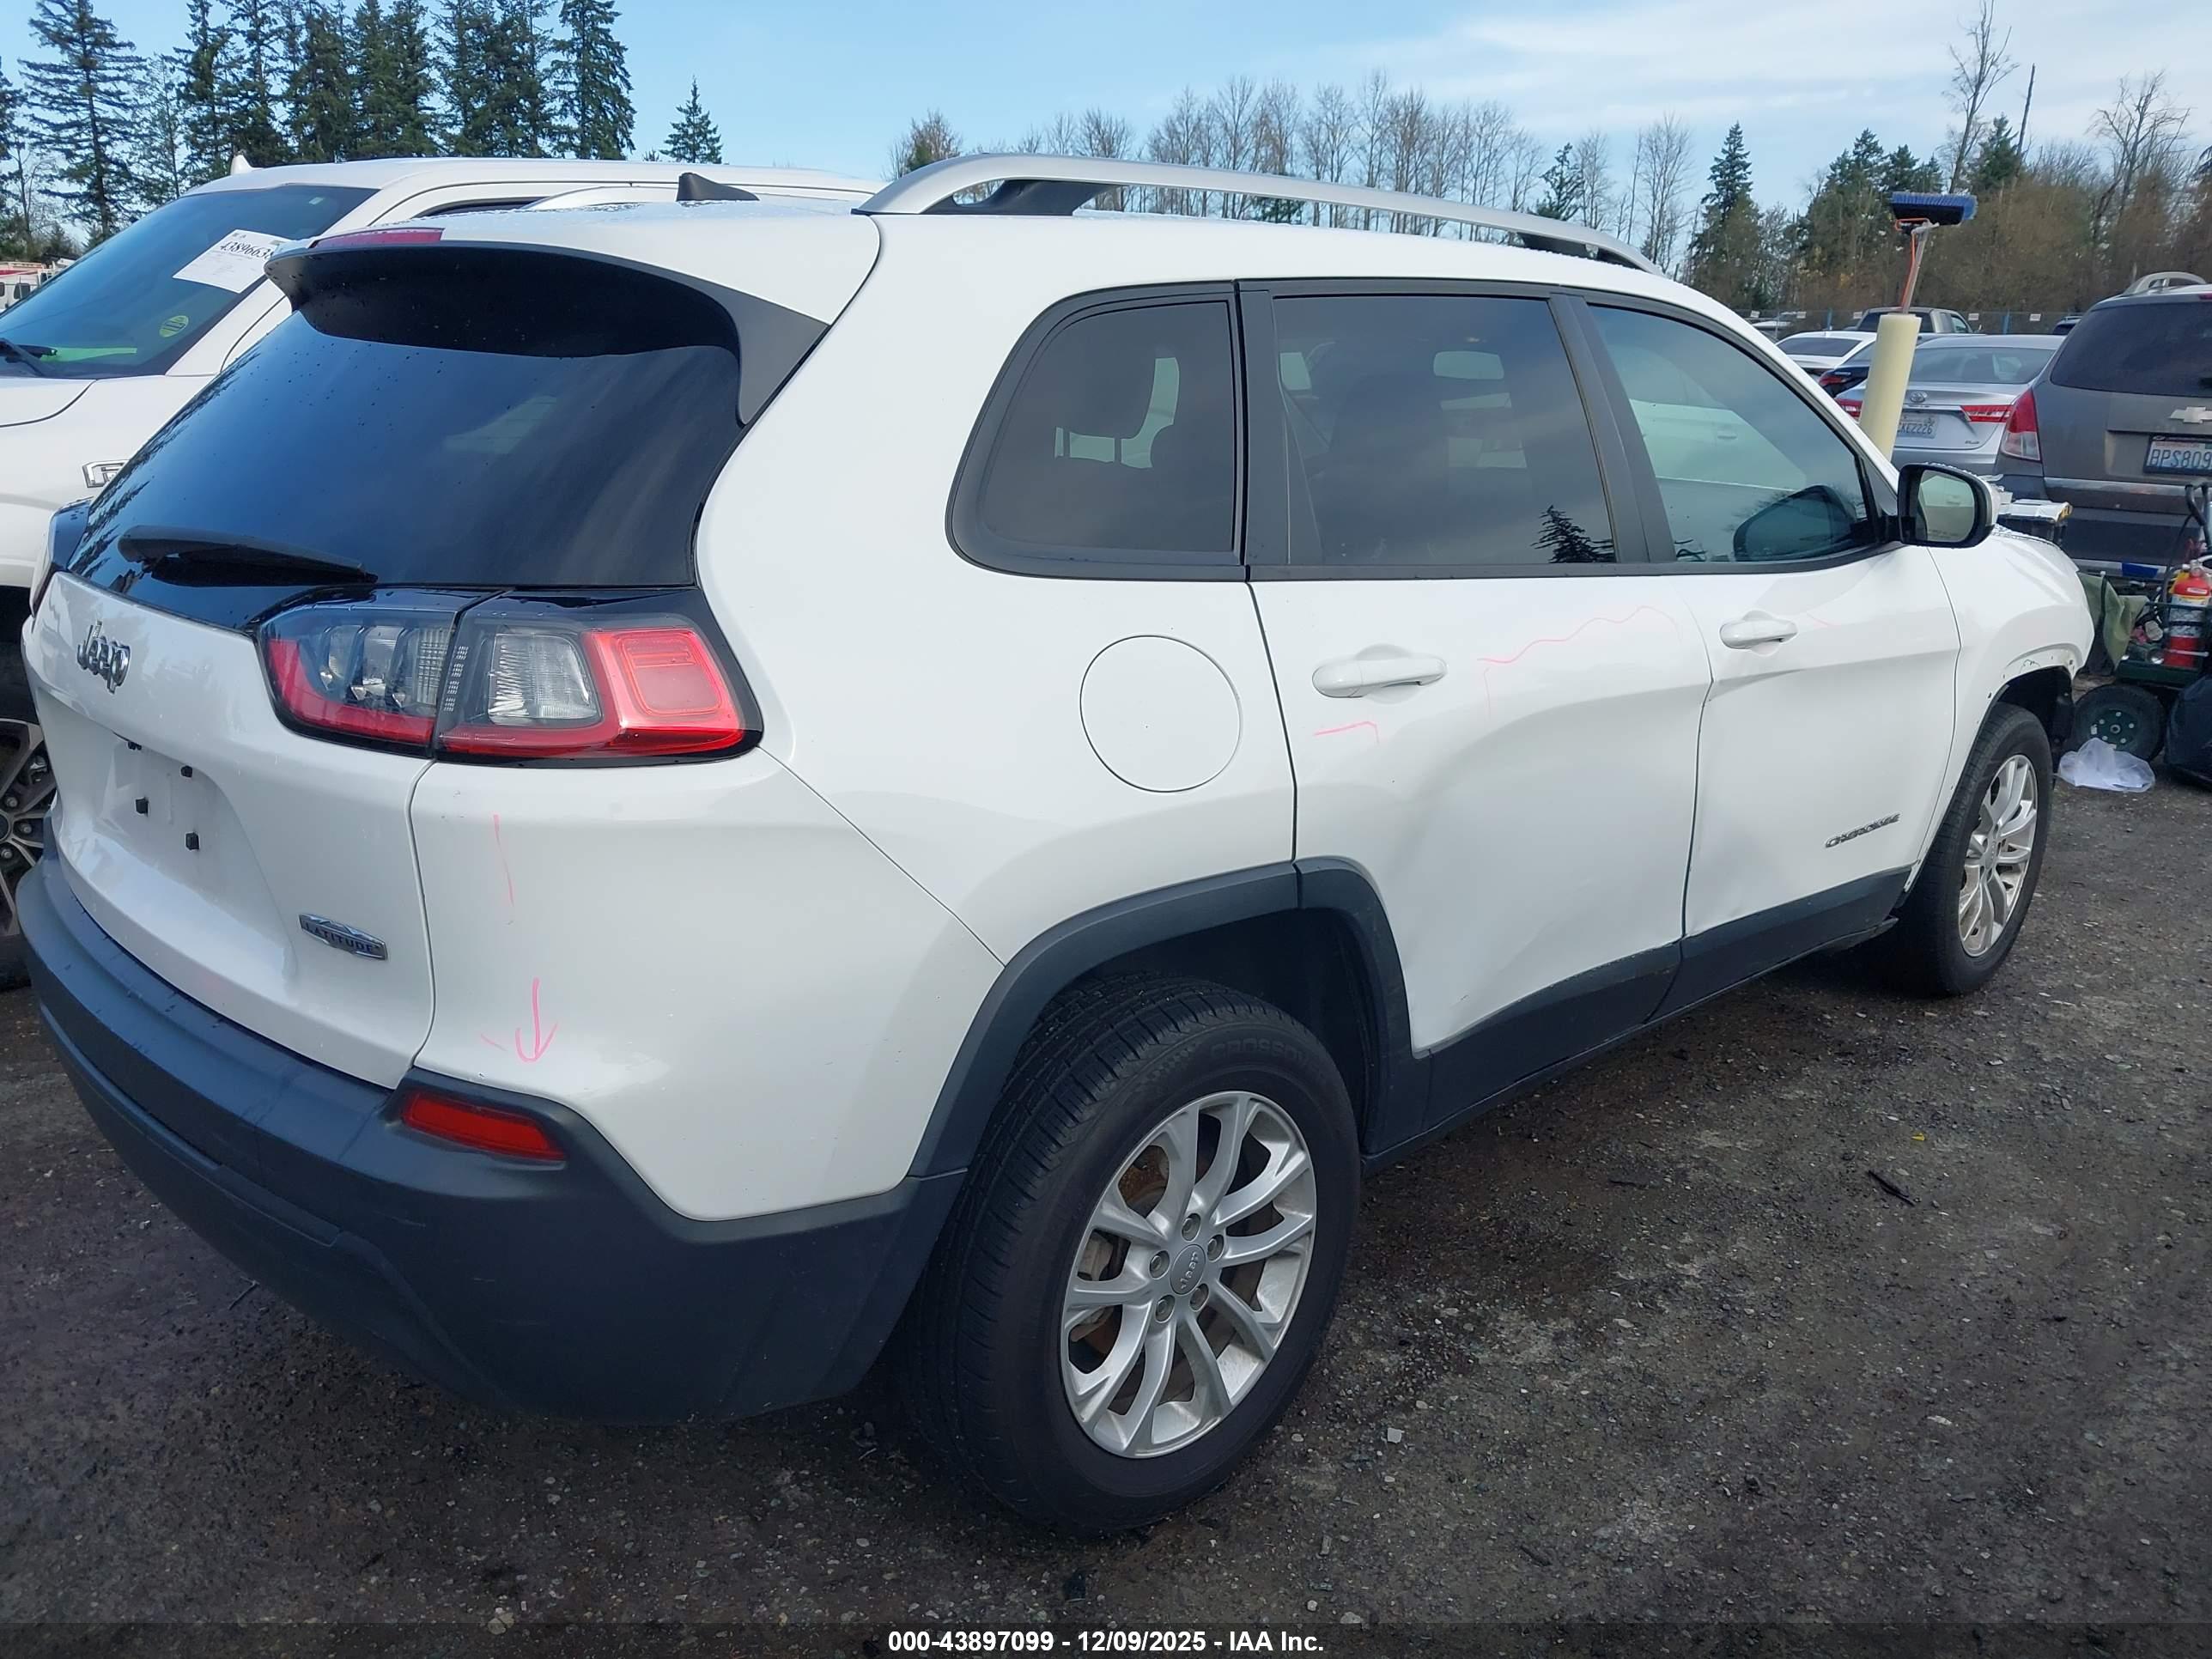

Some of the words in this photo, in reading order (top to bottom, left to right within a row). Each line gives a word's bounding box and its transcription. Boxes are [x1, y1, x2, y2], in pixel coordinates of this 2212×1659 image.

[77, 620, 131, 694] Jeep
[304, 921, 373, 953] LATITUDE
[1180, 1251, 1199, 1289] Jeep
